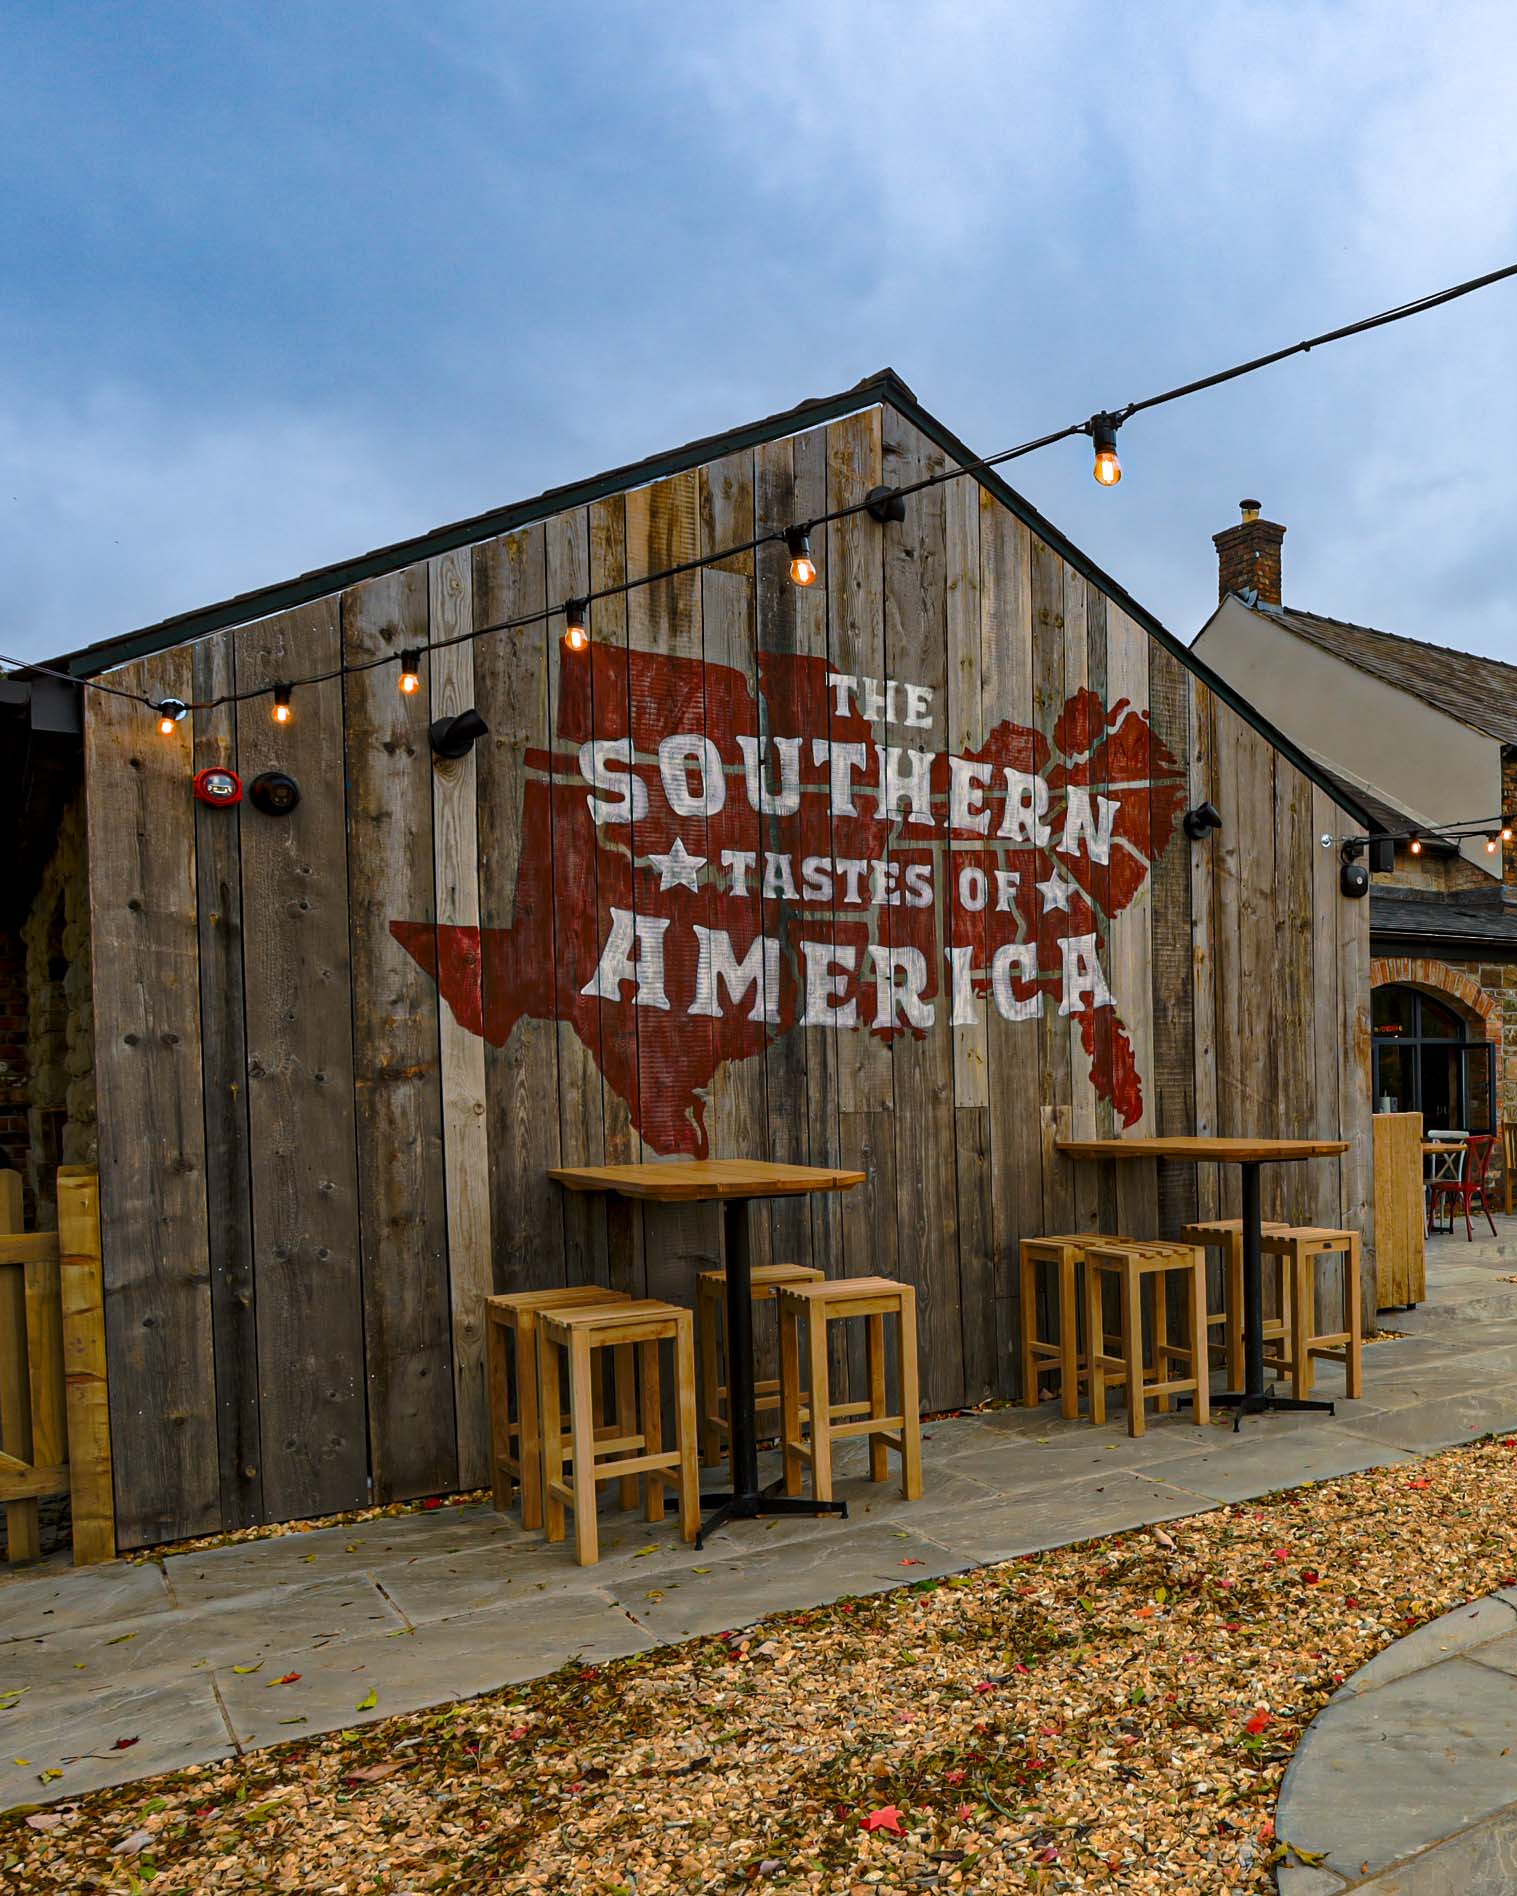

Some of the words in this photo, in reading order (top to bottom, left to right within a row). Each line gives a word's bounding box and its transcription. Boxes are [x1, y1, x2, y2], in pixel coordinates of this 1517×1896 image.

[826, 671, 934, 729] THE
[578, 733, 1121, 866] SOUTHERN
[719, 849, 934, 909] TASTES
[959, 866, 1021, 913] OF
[580, 905, 1117, 1028] AMERICA
